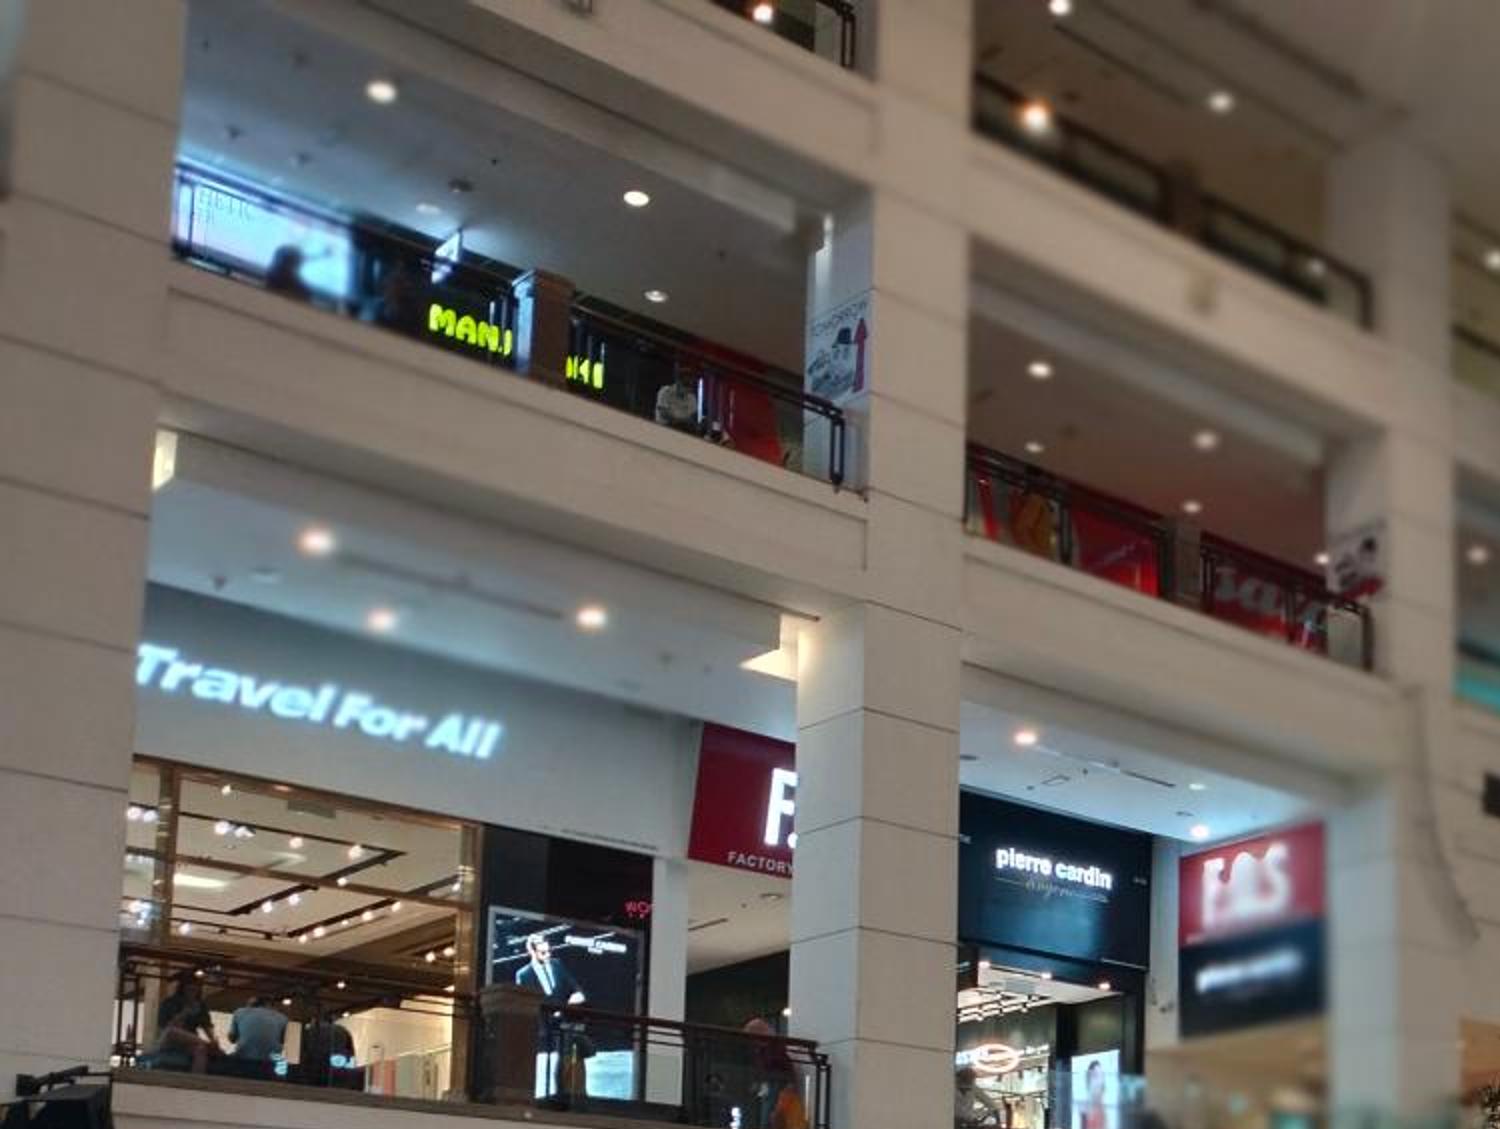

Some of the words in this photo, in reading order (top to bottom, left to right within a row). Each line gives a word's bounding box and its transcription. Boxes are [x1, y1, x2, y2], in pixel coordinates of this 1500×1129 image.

[135, 642, 338, 722] Travel
[333, 691, 428, 742] For
[425, 713, 506, 760] All
[995, 848, 1053, 876] pierre
[1055, 862, 1114, 890] cardin
